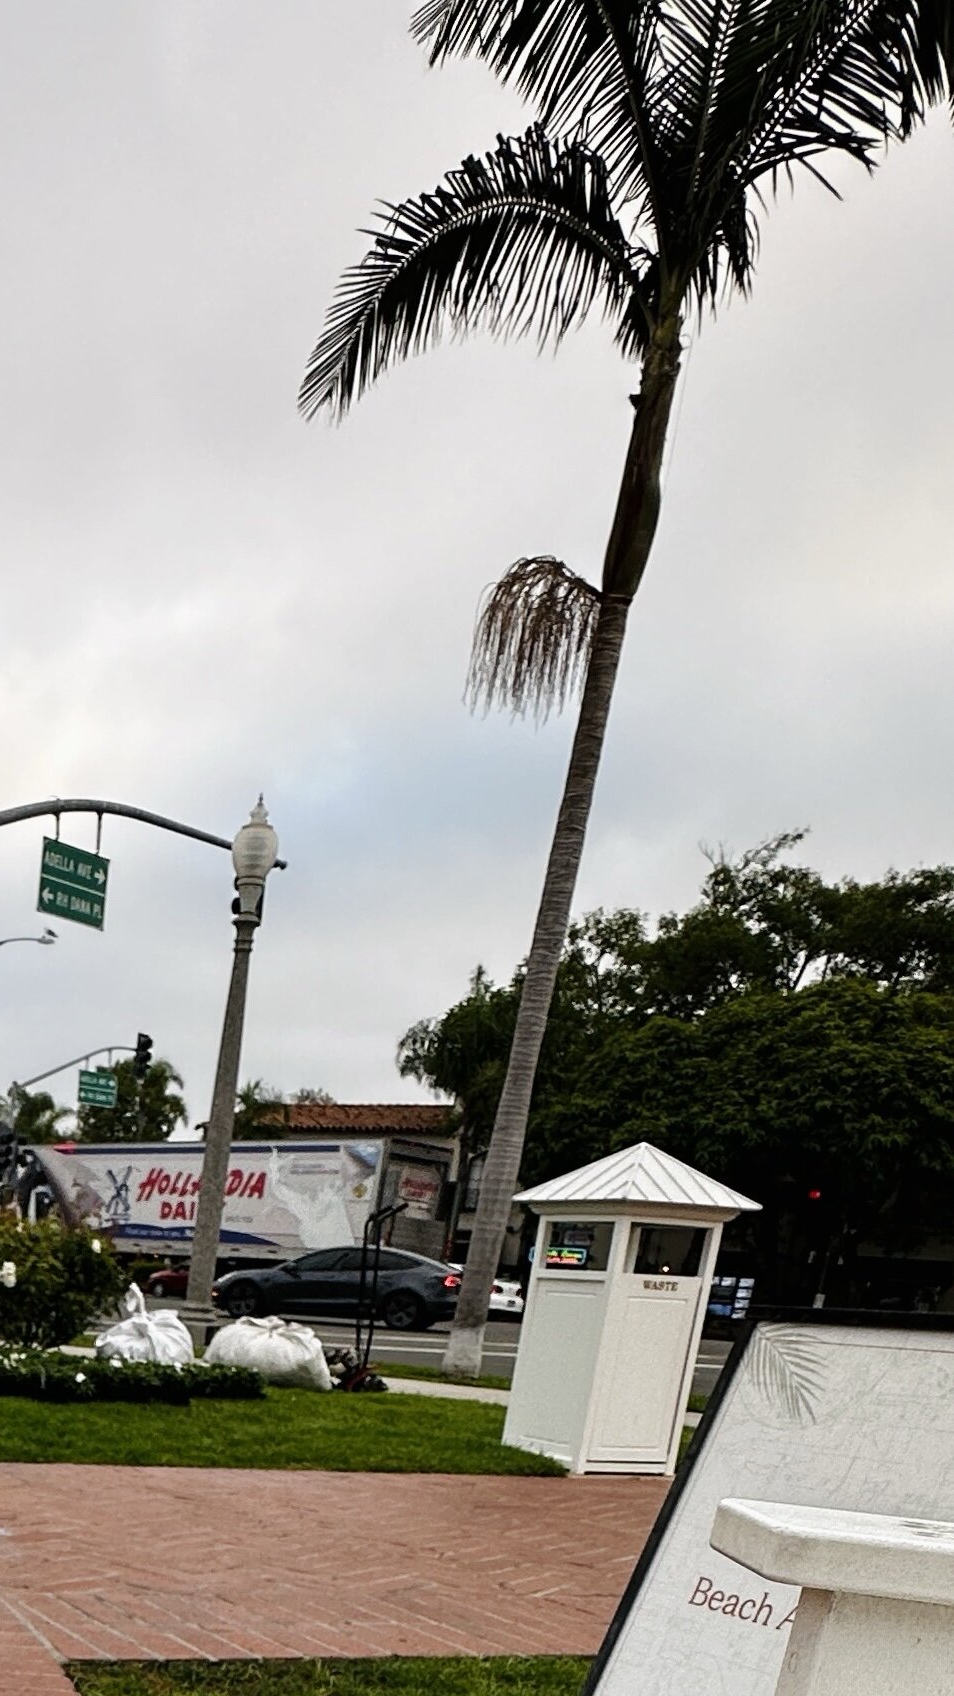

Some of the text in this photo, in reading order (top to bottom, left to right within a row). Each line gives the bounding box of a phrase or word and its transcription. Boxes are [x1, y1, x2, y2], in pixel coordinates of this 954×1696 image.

[44, 850, 75, 874] ADELLA
[136, 1167, 267, 1202] HOLLDIA
[159, 1200, 196, 1221] DAI
[643, 1280, 679, 1292] WASTE
[688, 1576, 774, 1627] Beach
